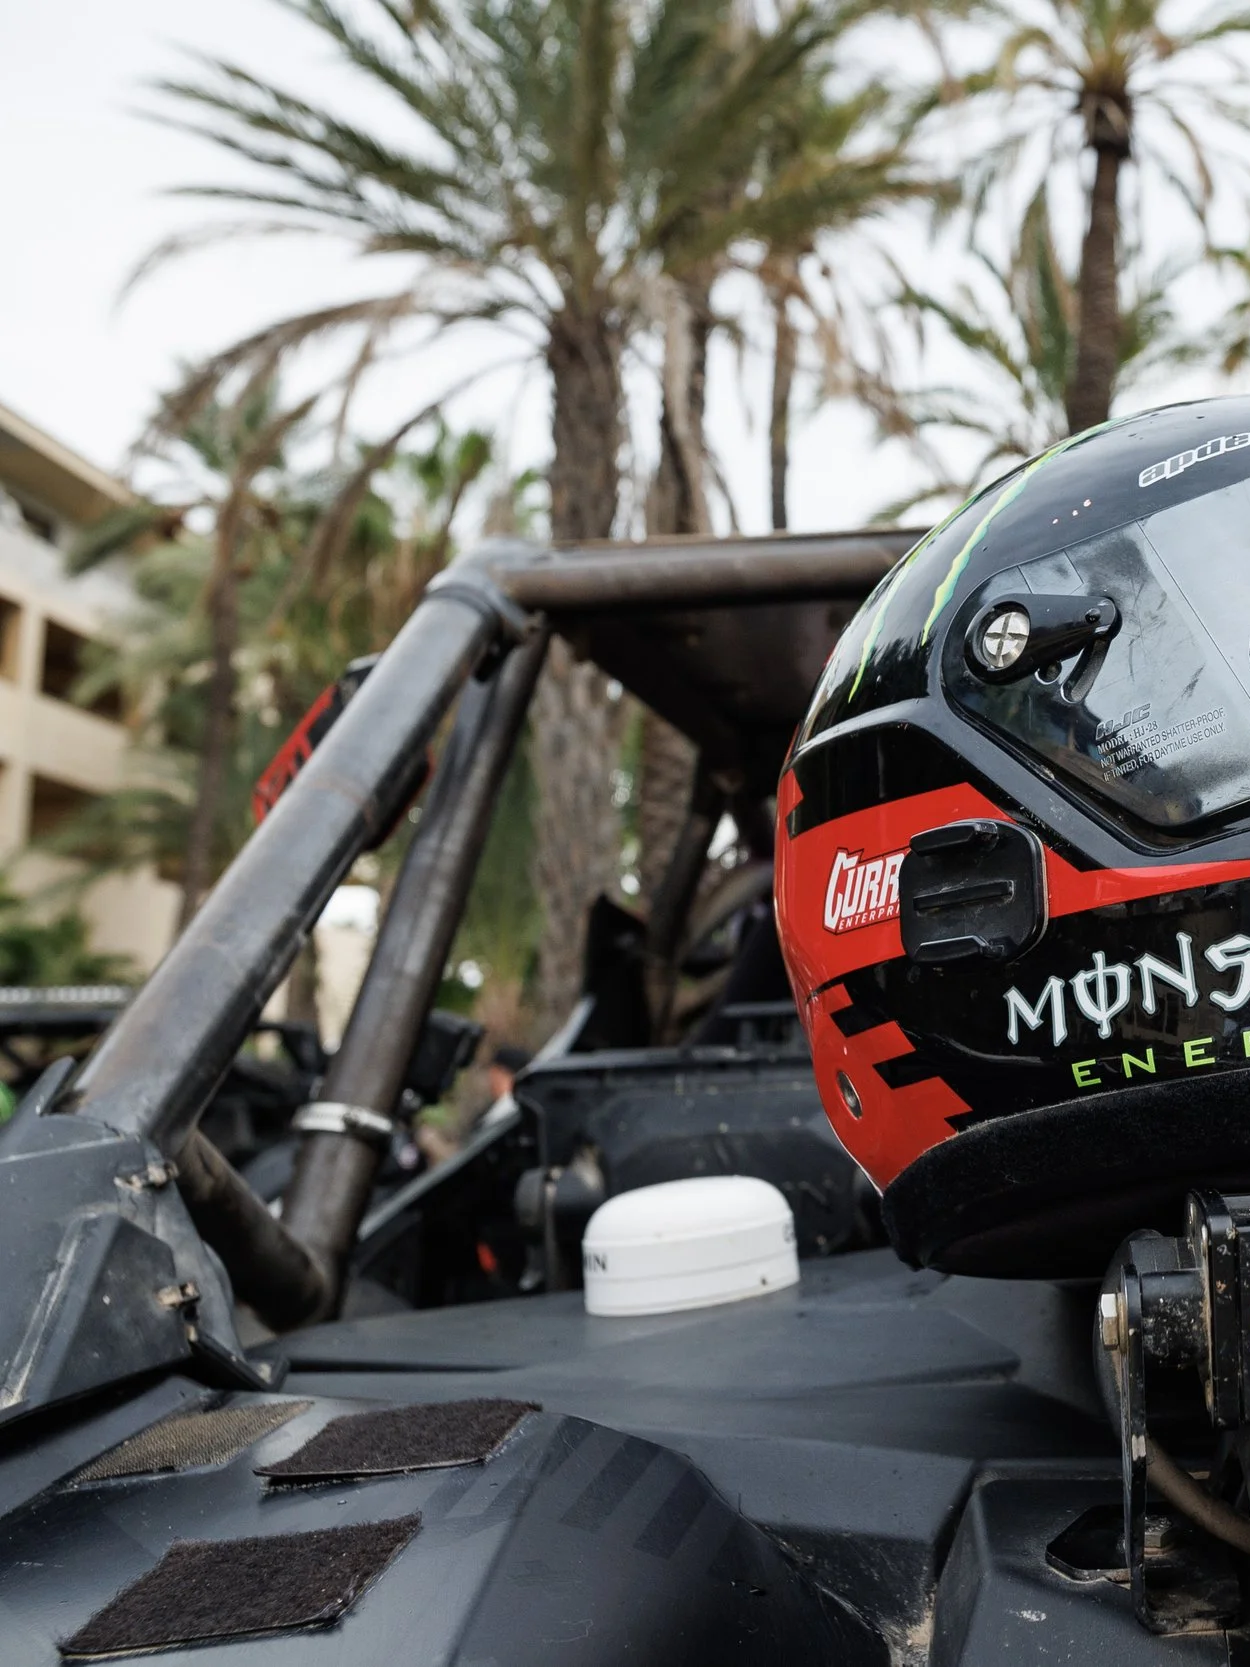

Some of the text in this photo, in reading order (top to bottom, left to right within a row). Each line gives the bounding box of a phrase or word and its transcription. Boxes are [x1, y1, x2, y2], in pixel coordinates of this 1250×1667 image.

[1096, 703, 1151, 741] HJC
[1097, 734, 1128, 755] MODEL
[1133, 720, 1158, 739] HJ-28
[1100, 753, 1115, 769] NOT
[1116, 733, 1161, 761] WARRANTED
[1103, 770, 1111, 782] IF
[1139, 752, 1154, 766] FOR
[1154, 738, 1187, 760] DAYTIME
[1187, 731, 1203, 746] USE
[1203, 722, 1226, 739] ONLY.
[825, 852, 905, 930] CURR
[839, 905, 900, 930] ENTERPRI
